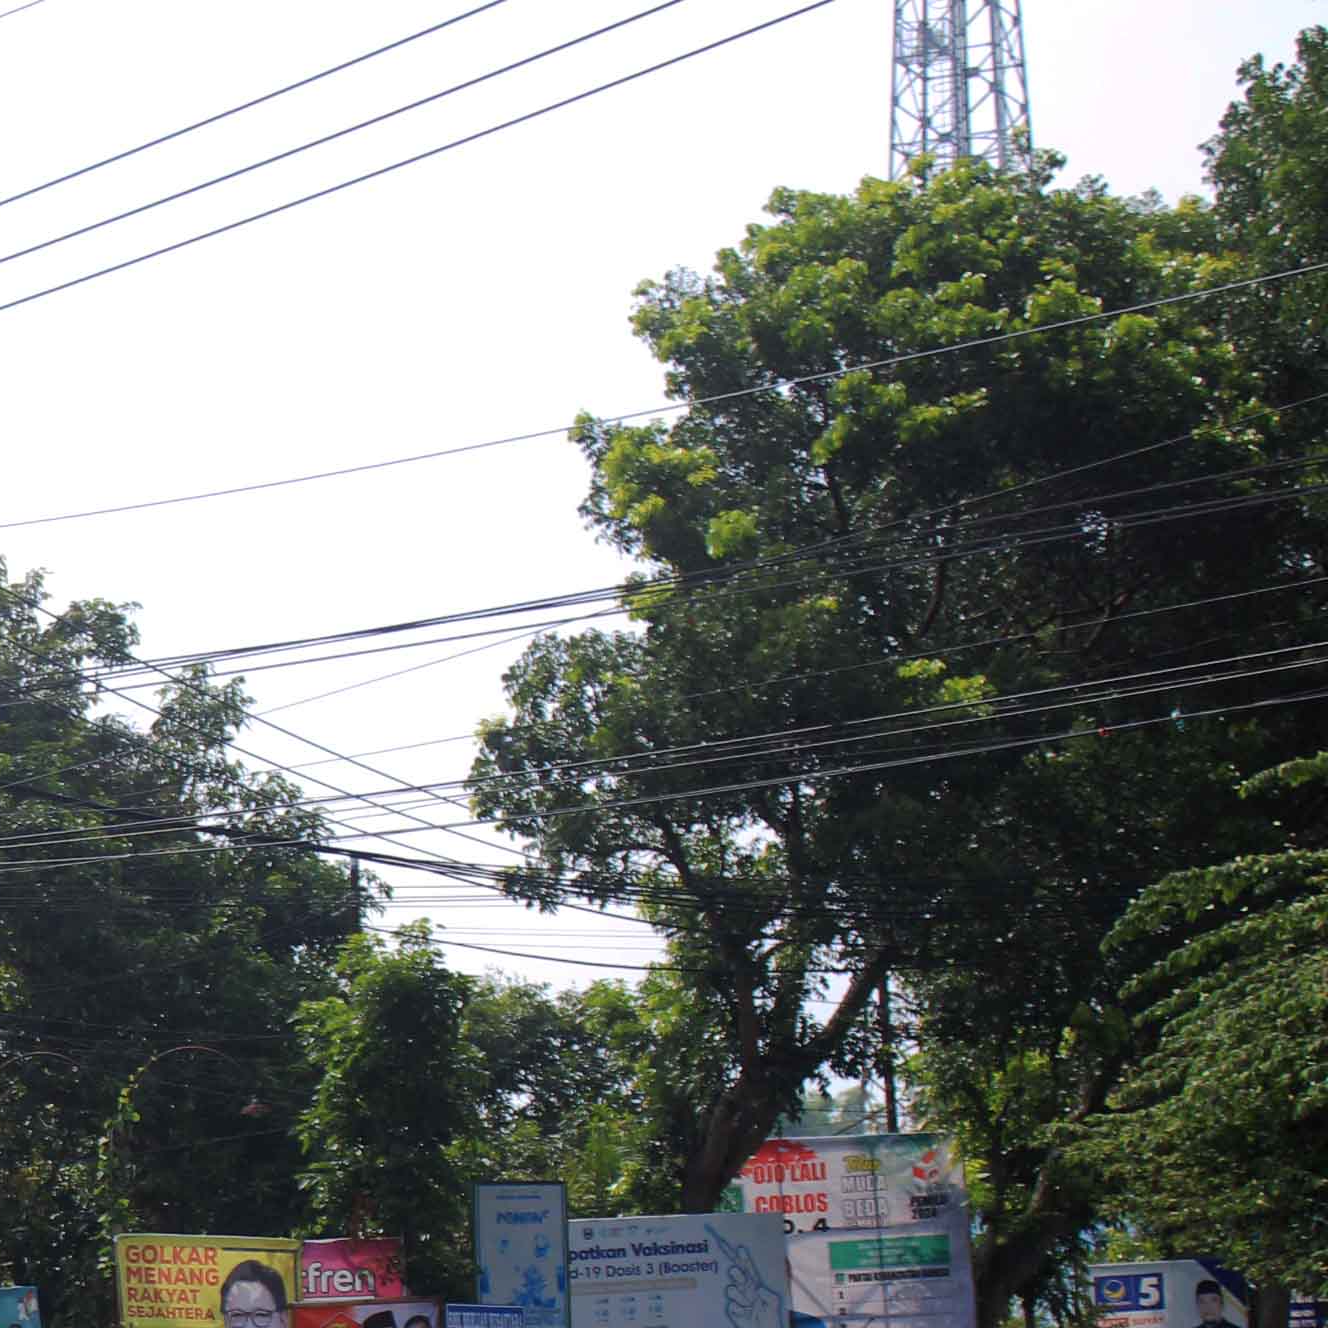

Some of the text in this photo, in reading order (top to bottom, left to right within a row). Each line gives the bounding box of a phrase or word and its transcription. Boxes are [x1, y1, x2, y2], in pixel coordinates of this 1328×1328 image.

[754, 1193, 829, 1213] COBLOS
[126, 1245, 219, 1265] GOLKAR
[630, 1239, 709, 1258] Vaksinasi
[126, 1266, 221, 1286] MENANG
[606, 1264, 641, 1278] Dosis
[646, 1263, 655, 1275] 3
[658, 1259, 719, 1278] (Booster)
[127, 1287, 201, 1305] RAKYAT
[1139, 1276, 1161, 1307] 5
[127, 1305, 216, 1321] SEJAHTERA
